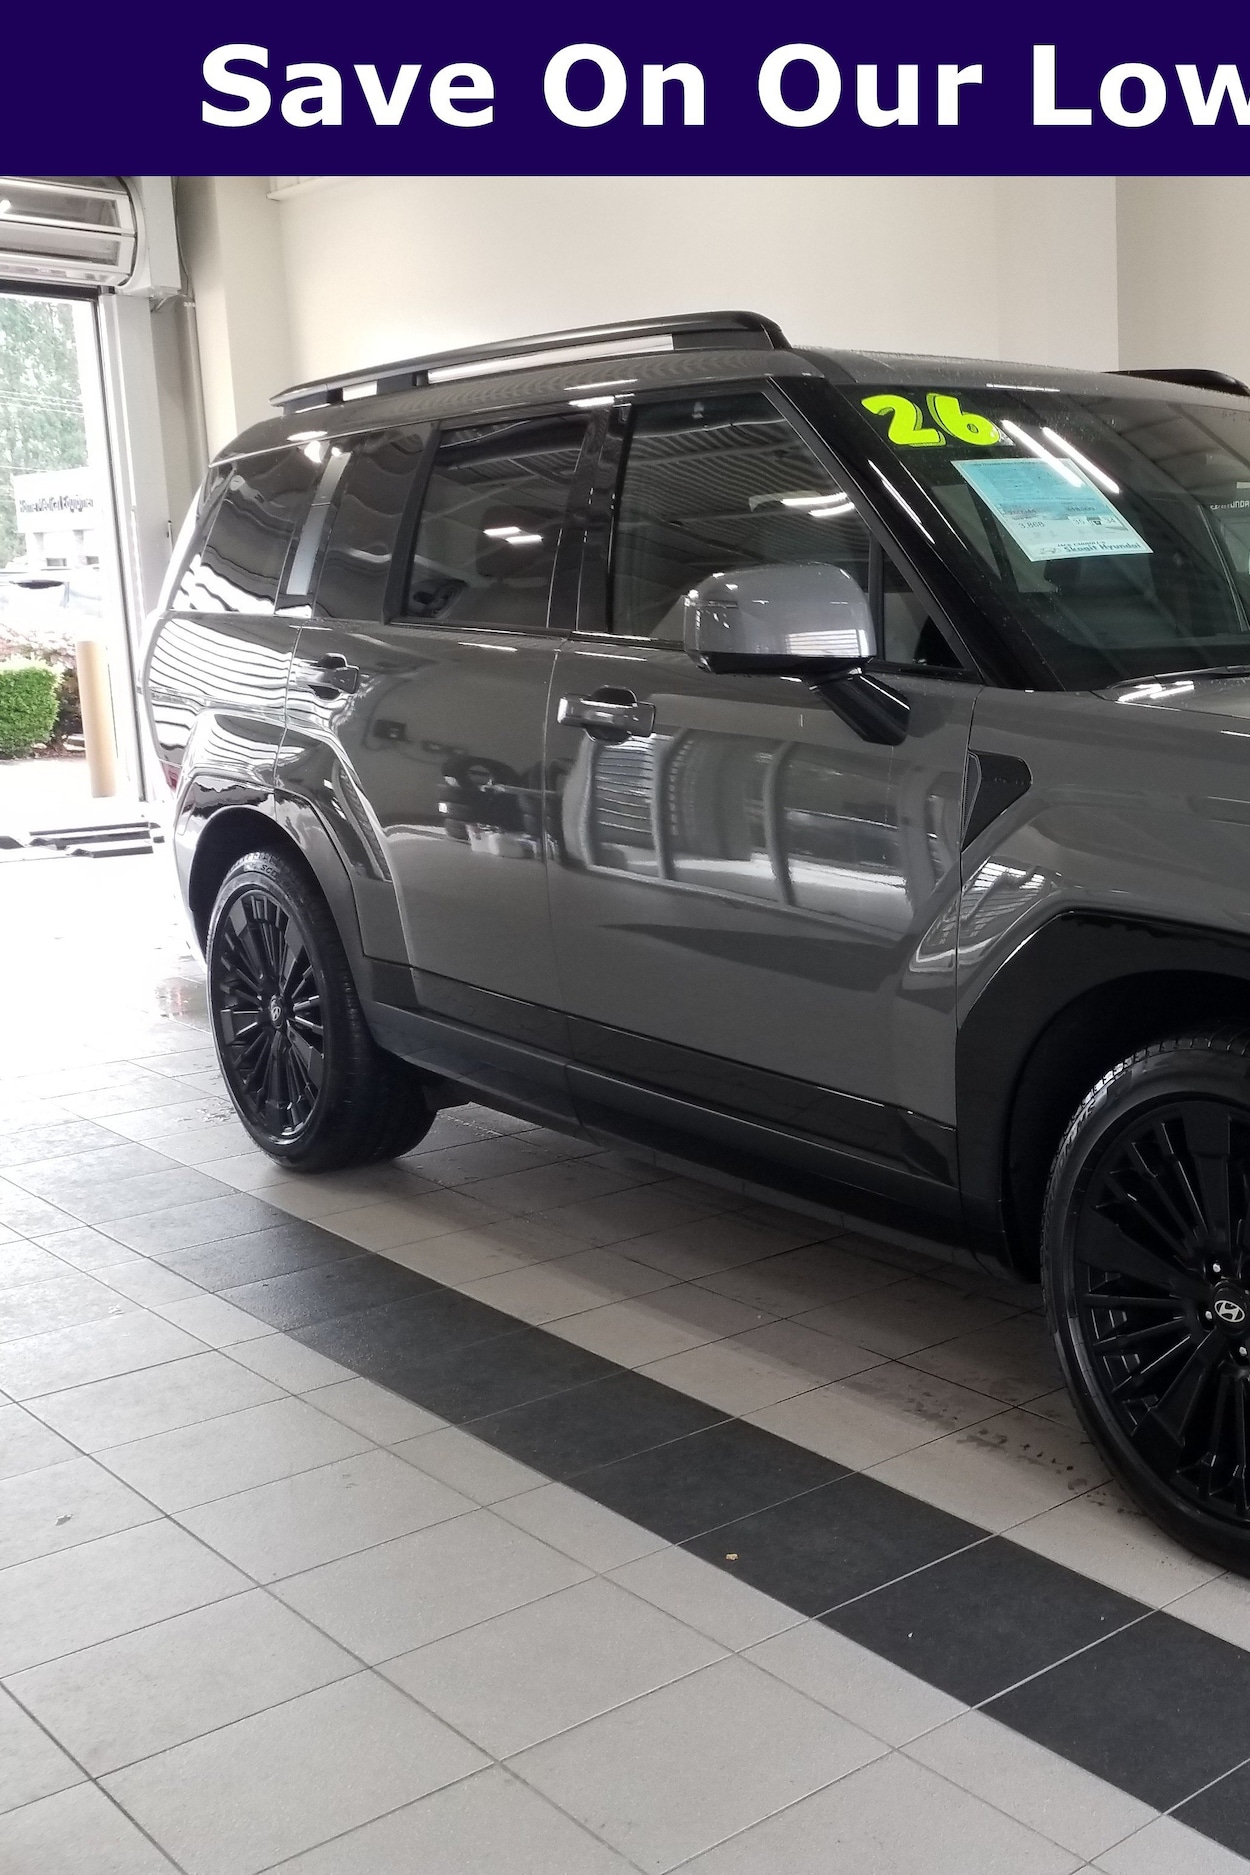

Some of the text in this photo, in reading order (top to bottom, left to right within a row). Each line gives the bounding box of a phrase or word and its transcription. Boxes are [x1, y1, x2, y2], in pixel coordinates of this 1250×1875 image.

[860, 392, 1002, 447] 26
[1063, 542, 1142, 553] Skagit Hyundai
